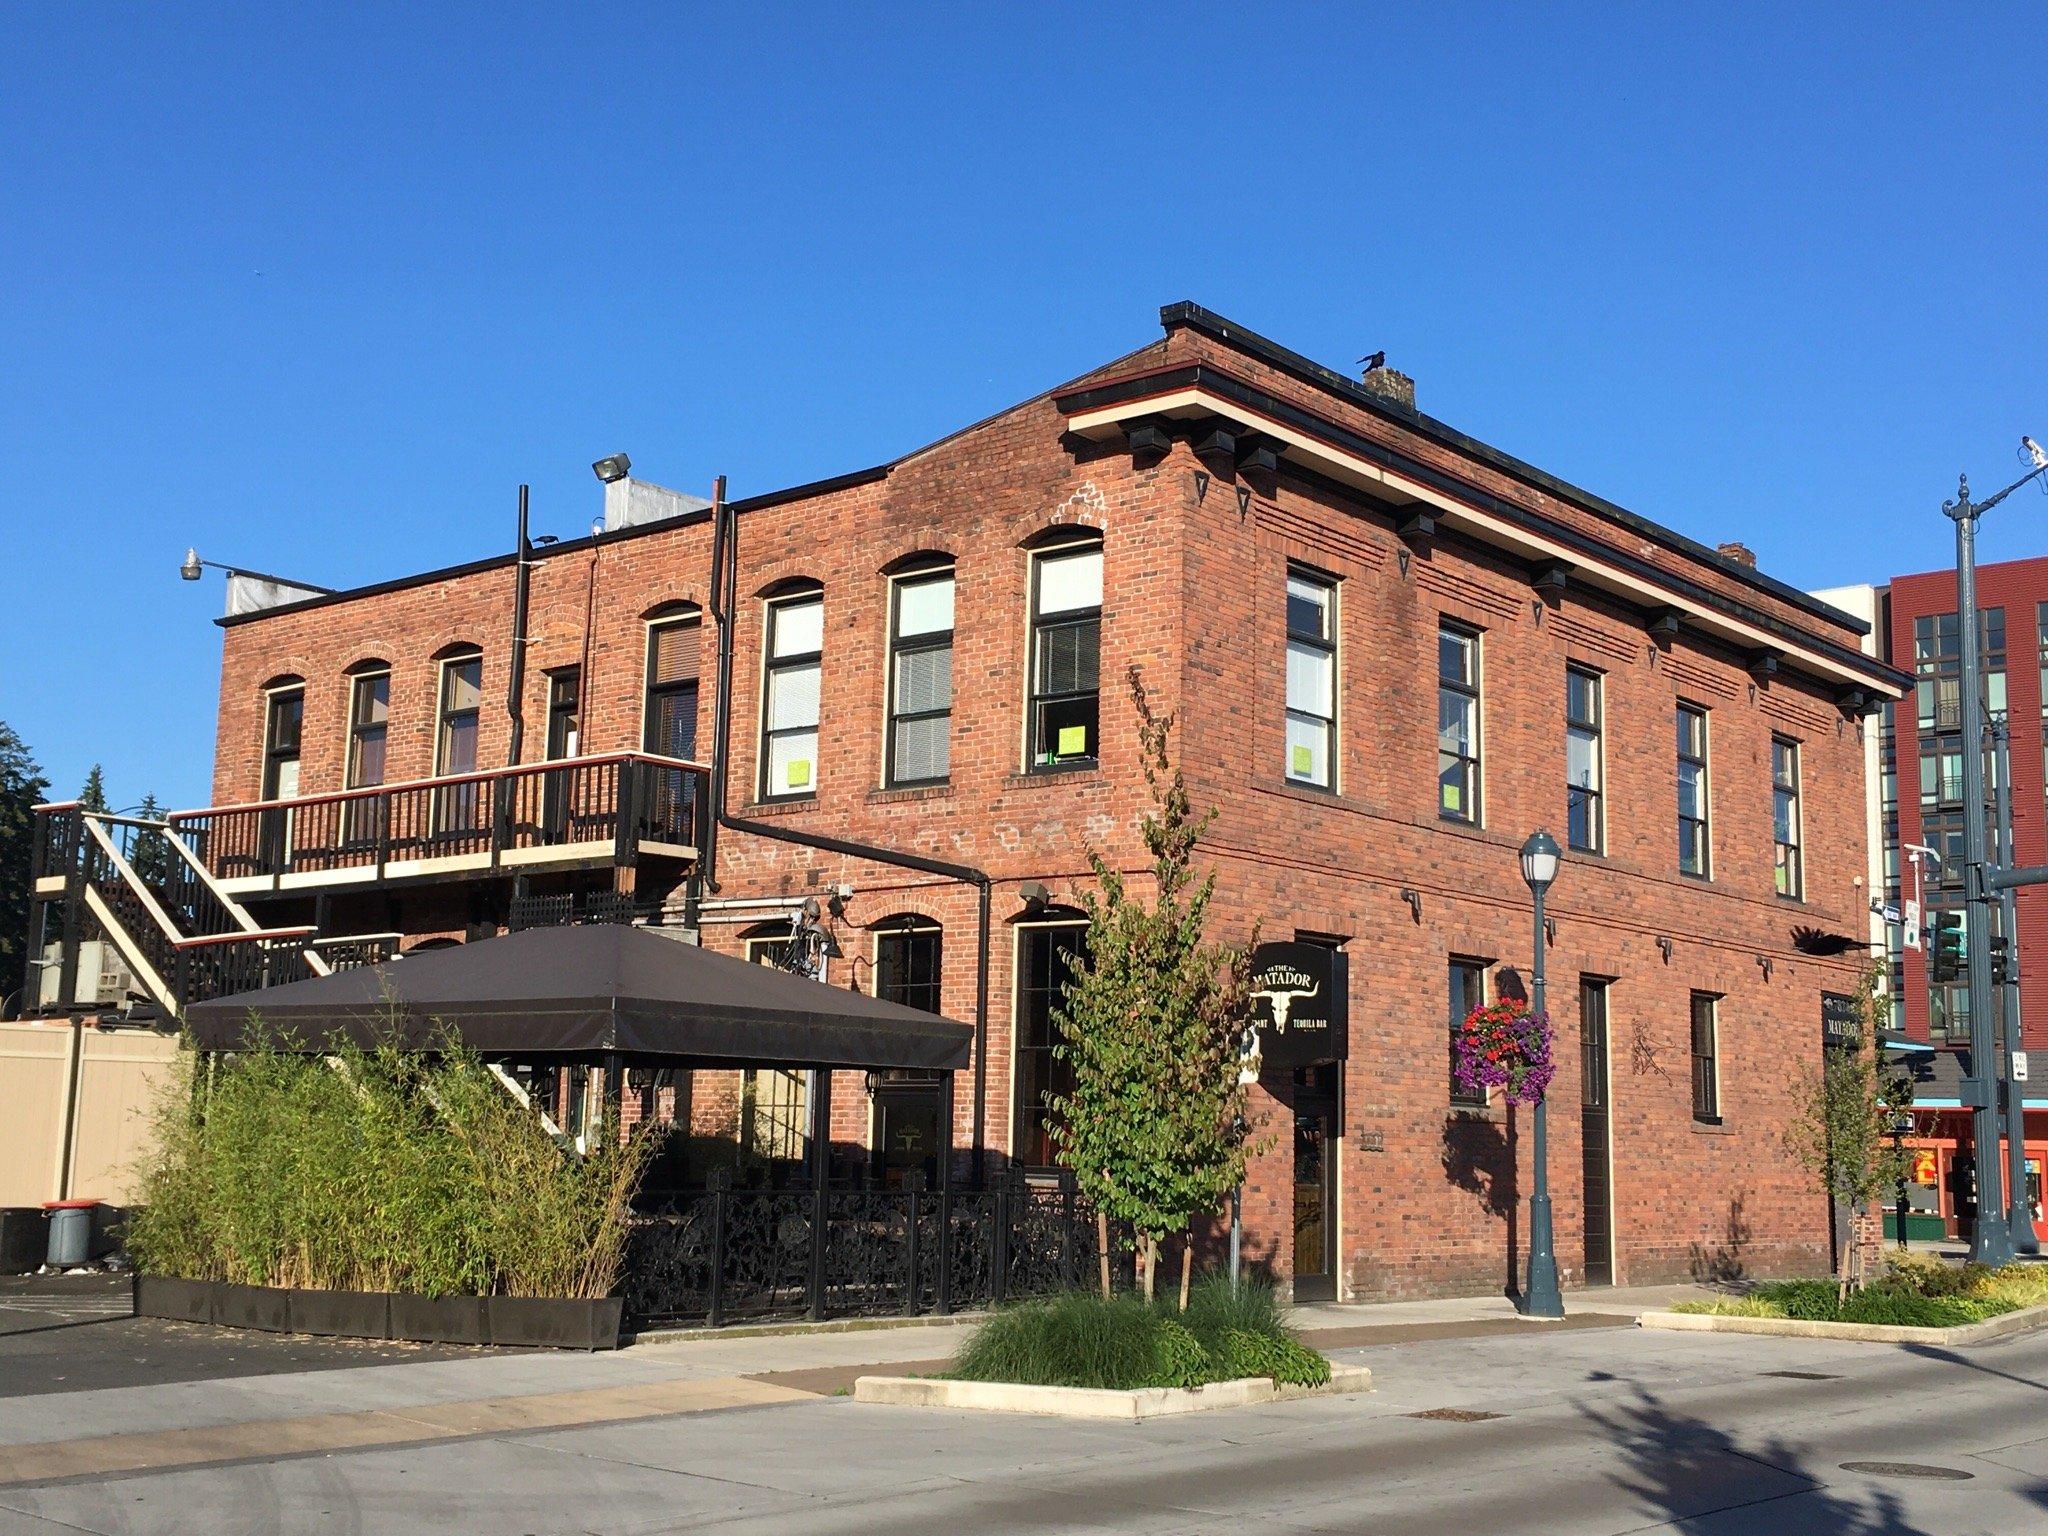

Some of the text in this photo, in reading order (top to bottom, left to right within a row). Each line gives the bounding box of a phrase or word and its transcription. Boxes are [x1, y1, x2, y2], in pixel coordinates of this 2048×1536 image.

[1274, 964, 1288, 972] THE
[1293, 1019, 1327, 1028] TEQUILA BAR
